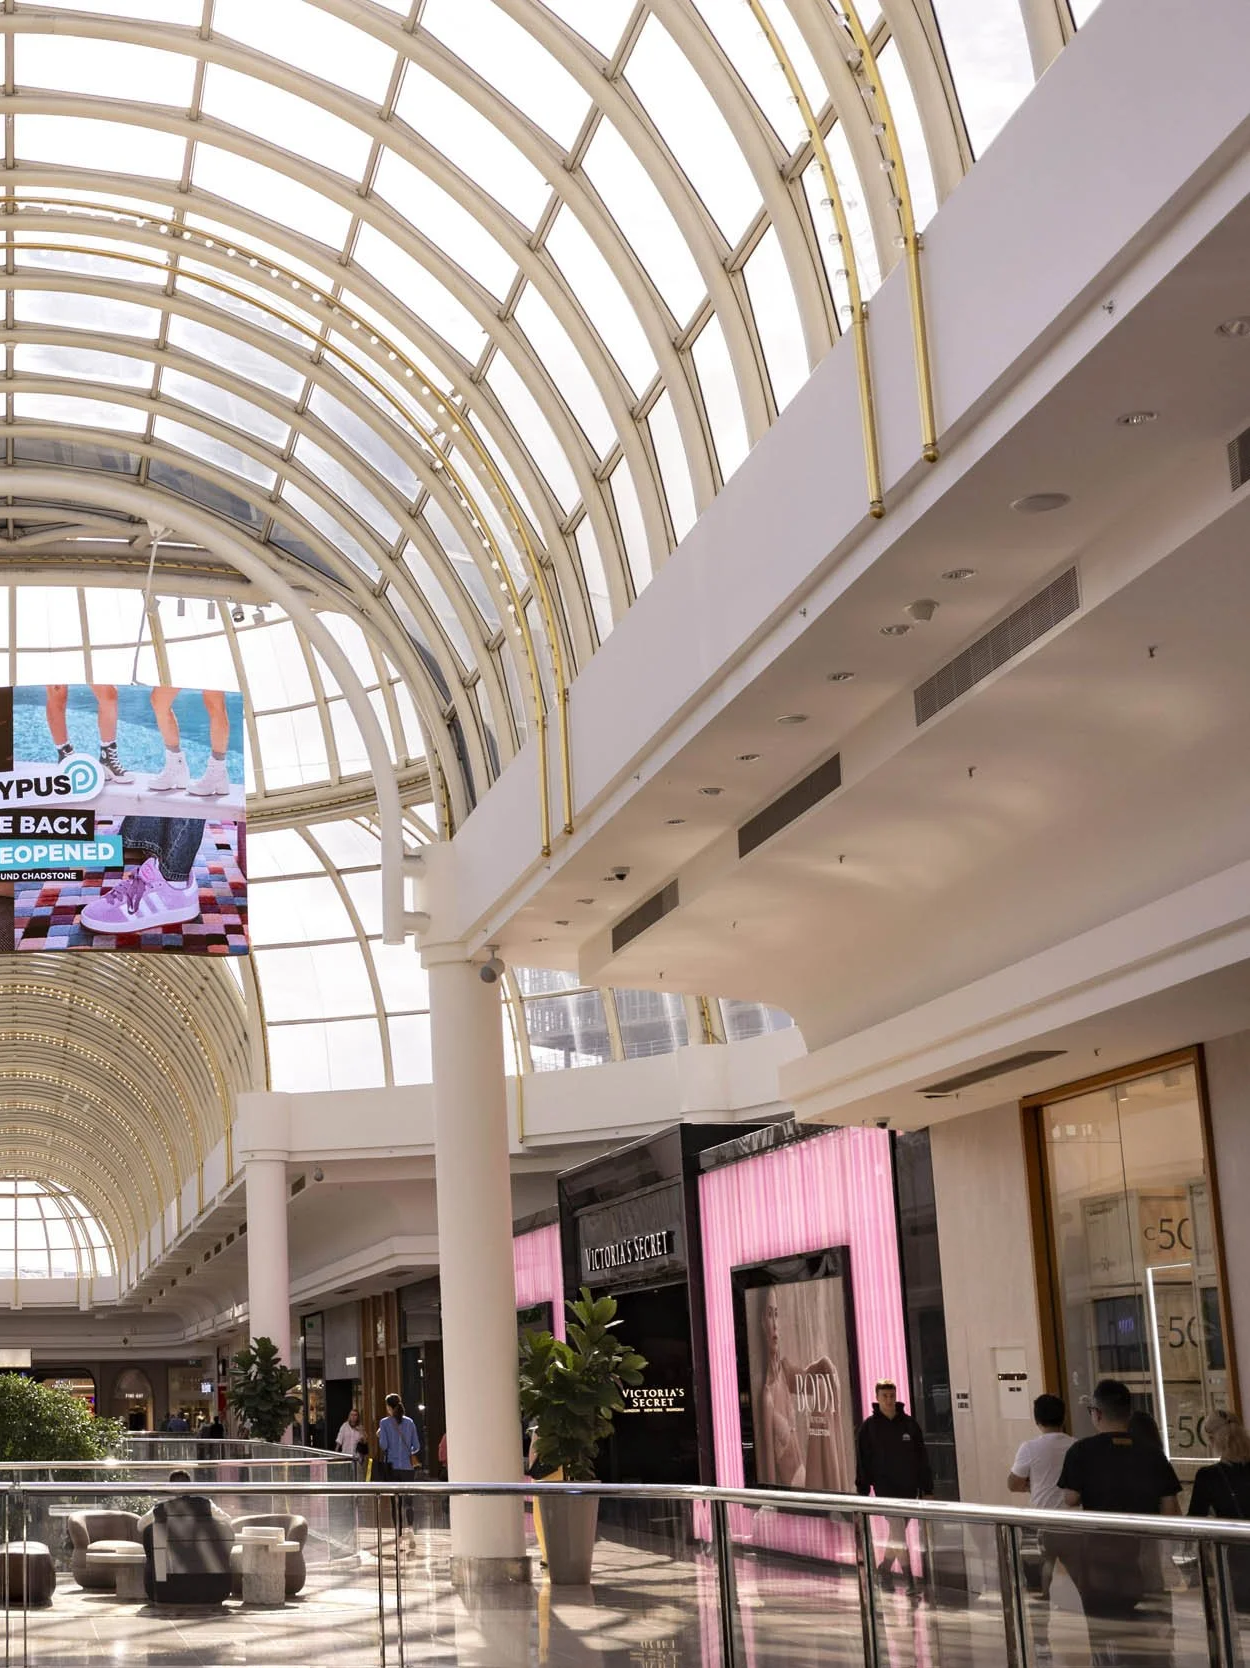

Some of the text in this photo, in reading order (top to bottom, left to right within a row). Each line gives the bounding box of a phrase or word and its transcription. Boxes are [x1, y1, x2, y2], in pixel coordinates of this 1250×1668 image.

[20, 815, 87, 835] BACK
[22, 872, 77, 880] CHADSTONE
[585, 1231, 667, 1271] VICTORIA'S SECRET
[622, 1388, 685, 1398] VICTORIA'S
[795, 1373, 837, 1413] BODY
[632, 1398, 674, 1407] SECRET
